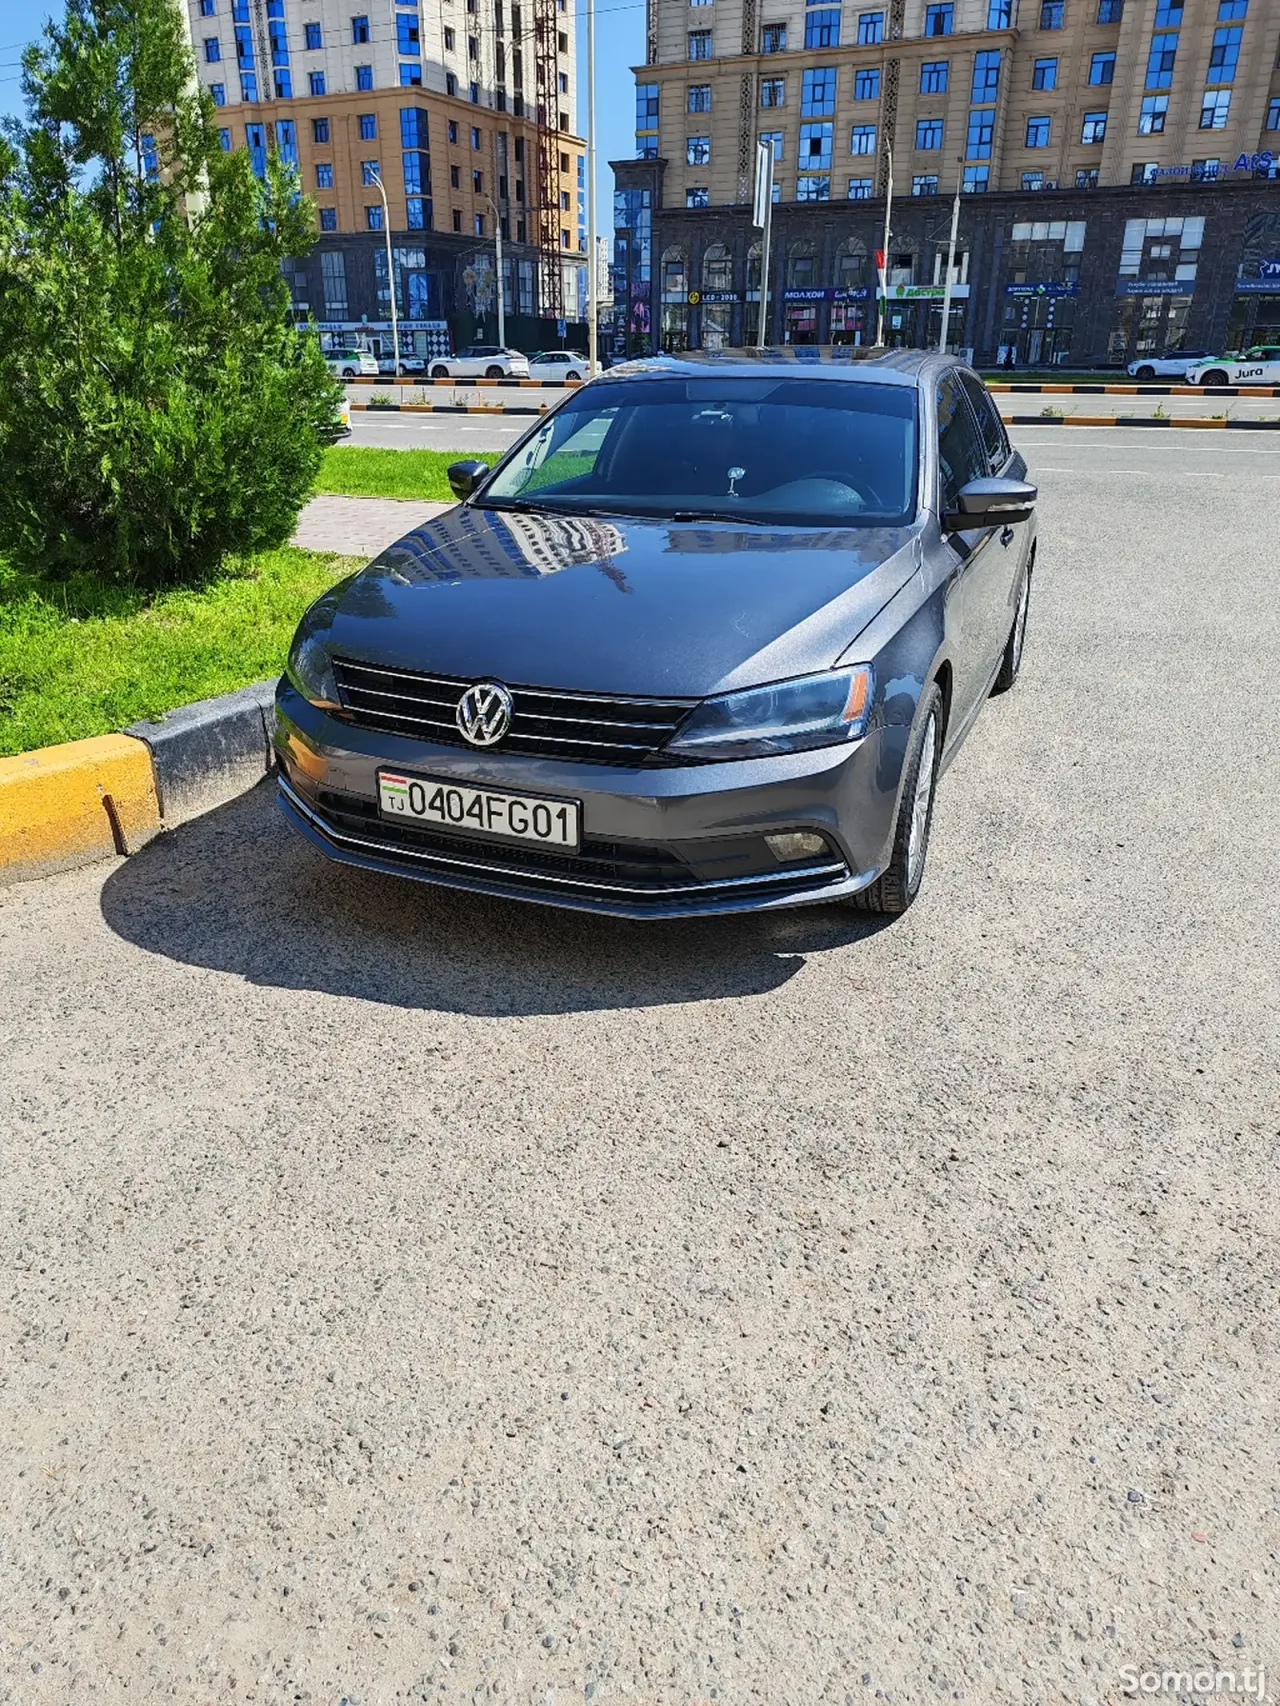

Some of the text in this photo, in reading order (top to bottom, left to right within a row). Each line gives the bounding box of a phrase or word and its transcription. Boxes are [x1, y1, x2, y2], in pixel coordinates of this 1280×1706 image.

[1234, 368, 1264, 379] Jura
[388, 796, 405, 812] TJ
[408, 782, 568, 842] 0404FG01
